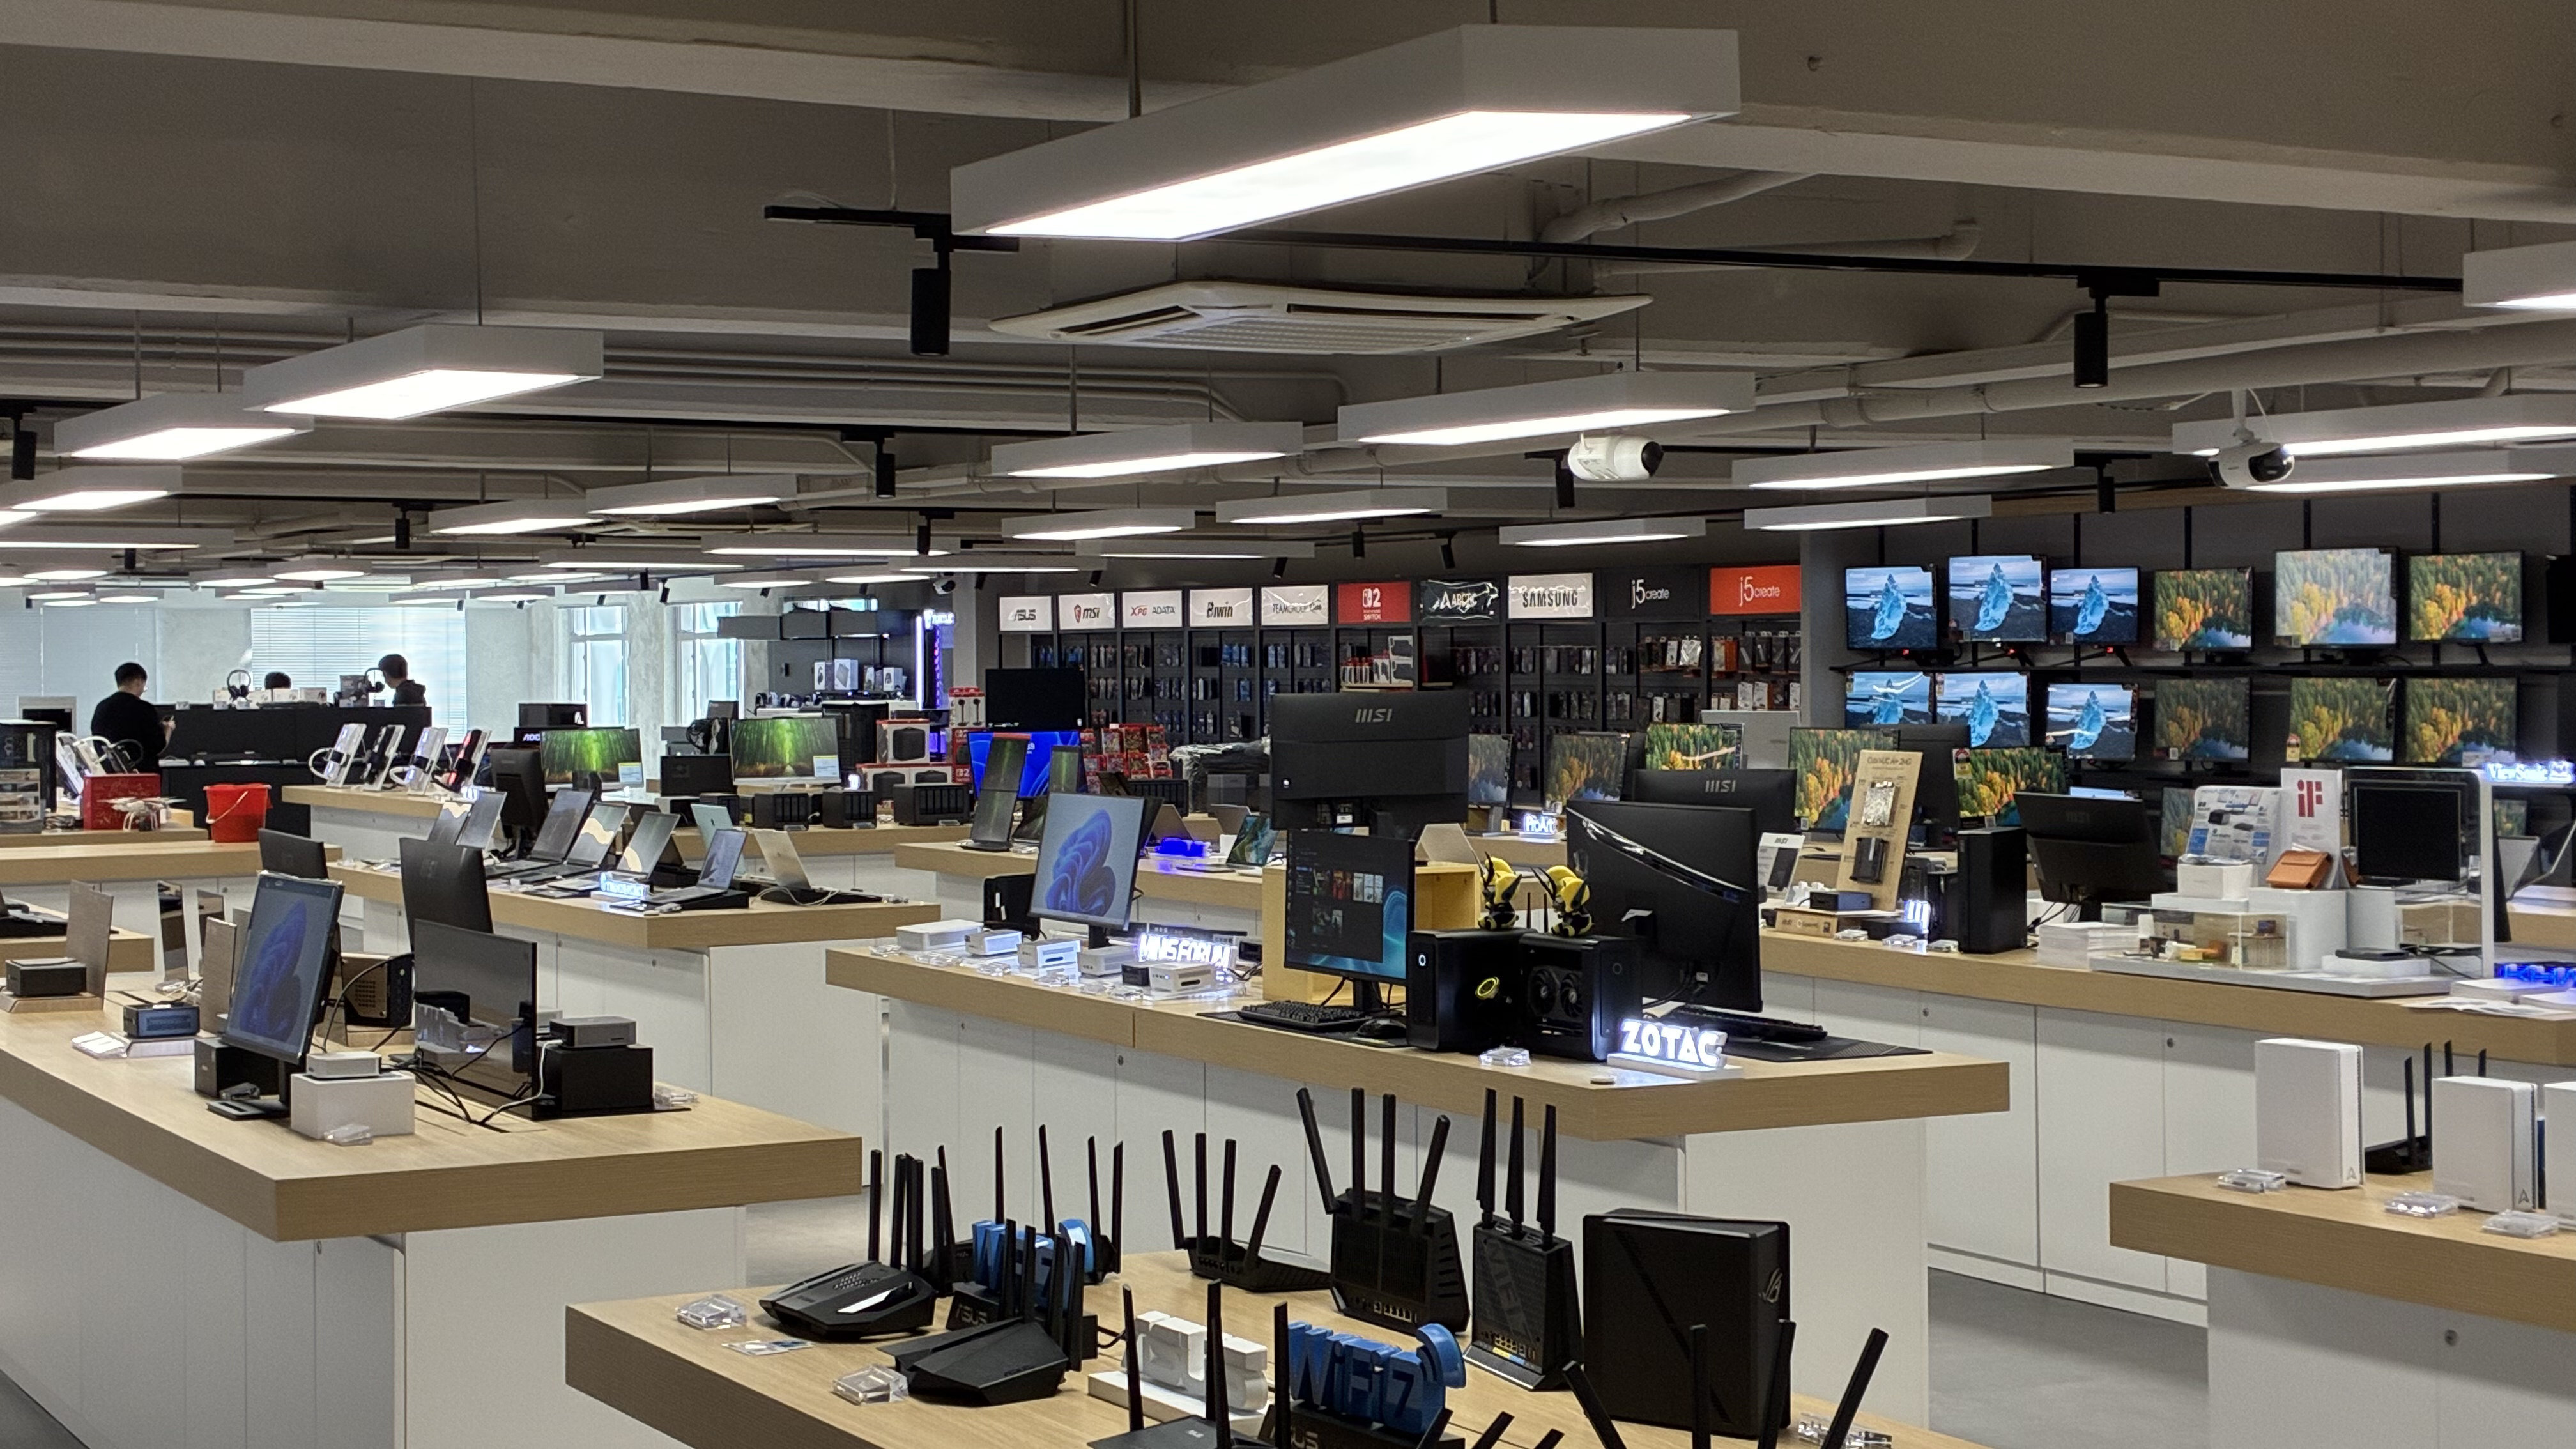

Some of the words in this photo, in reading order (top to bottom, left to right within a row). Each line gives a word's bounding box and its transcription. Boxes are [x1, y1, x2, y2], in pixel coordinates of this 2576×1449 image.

[1522, 591, 1578, 608] SAMSUNG
[1631, 579, 1670, 609] j5create
[1739, 576, 1781, 607] j5create
[1013, 609, 1036, 621] ASUS
[1130, 605, 1148, 617] XPG
[1152, 606, 1176, 615] ADATA
[1355, 709, 1393, 723] MSI
[1705, 779, 1736, 792] MSI
[1524, 813, 1556, 833] ProArt
[1621, 1019, 1726, 1068] ZOTAC
